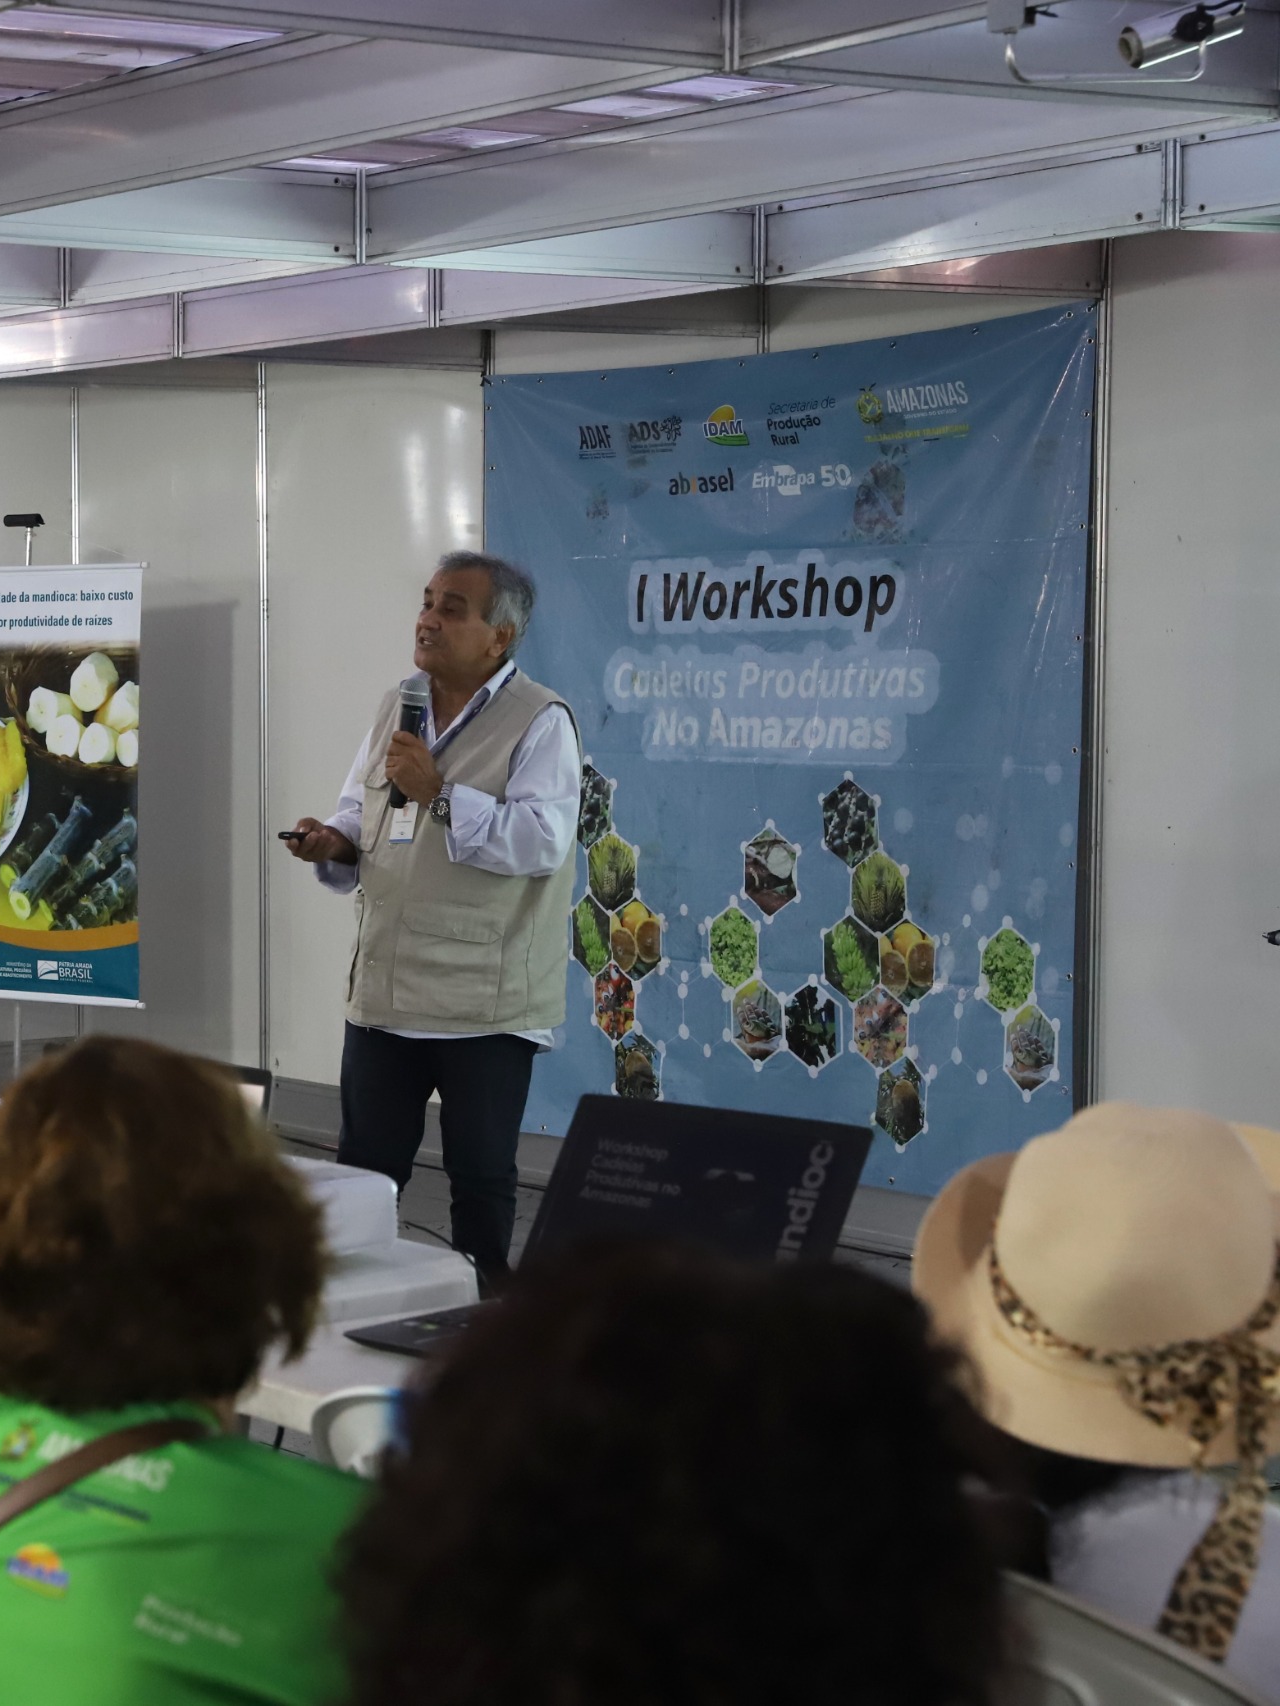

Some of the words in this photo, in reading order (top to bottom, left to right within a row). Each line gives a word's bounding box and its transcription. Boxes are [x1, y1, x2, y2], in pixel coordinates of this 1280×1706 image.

[768, 399, 819, 415] Secretaria
[821, 396, 836, 409] de
[886, 381, 969, 413] AMAZONAS
[628, 421, 661, 442] ADS
[703, 419, 745, 438] IDAM
[767, 415, 821, 431] Produção
[579, 425, 611, 450] ADAF
[771, 432, 800, 446] Rural
[752, 469, 815, 490] Embrapa
[821, 463, 852, 487] 50
[19, 591, 30, 603] da
[32, 590, 78, 602] mandioca:
[80, 589, 106, 601] baixo
[108, 590, 134, 601] custo
[636, 574, 648, 623] I
[663, 563, 897, 632] Workshop
[9, 615, 70, 630] produtividade
[72, 614, 83, 626] de
[85, 614, 113, 626] raízes
[614, 660, 728, 700] Cadeias
[738, 657, 926, 701] Produtivas
[652, 707, 700, 747] No
[709, 707, 892, 750] Amazonas
[59, 968, 93, 979] BRASIL
